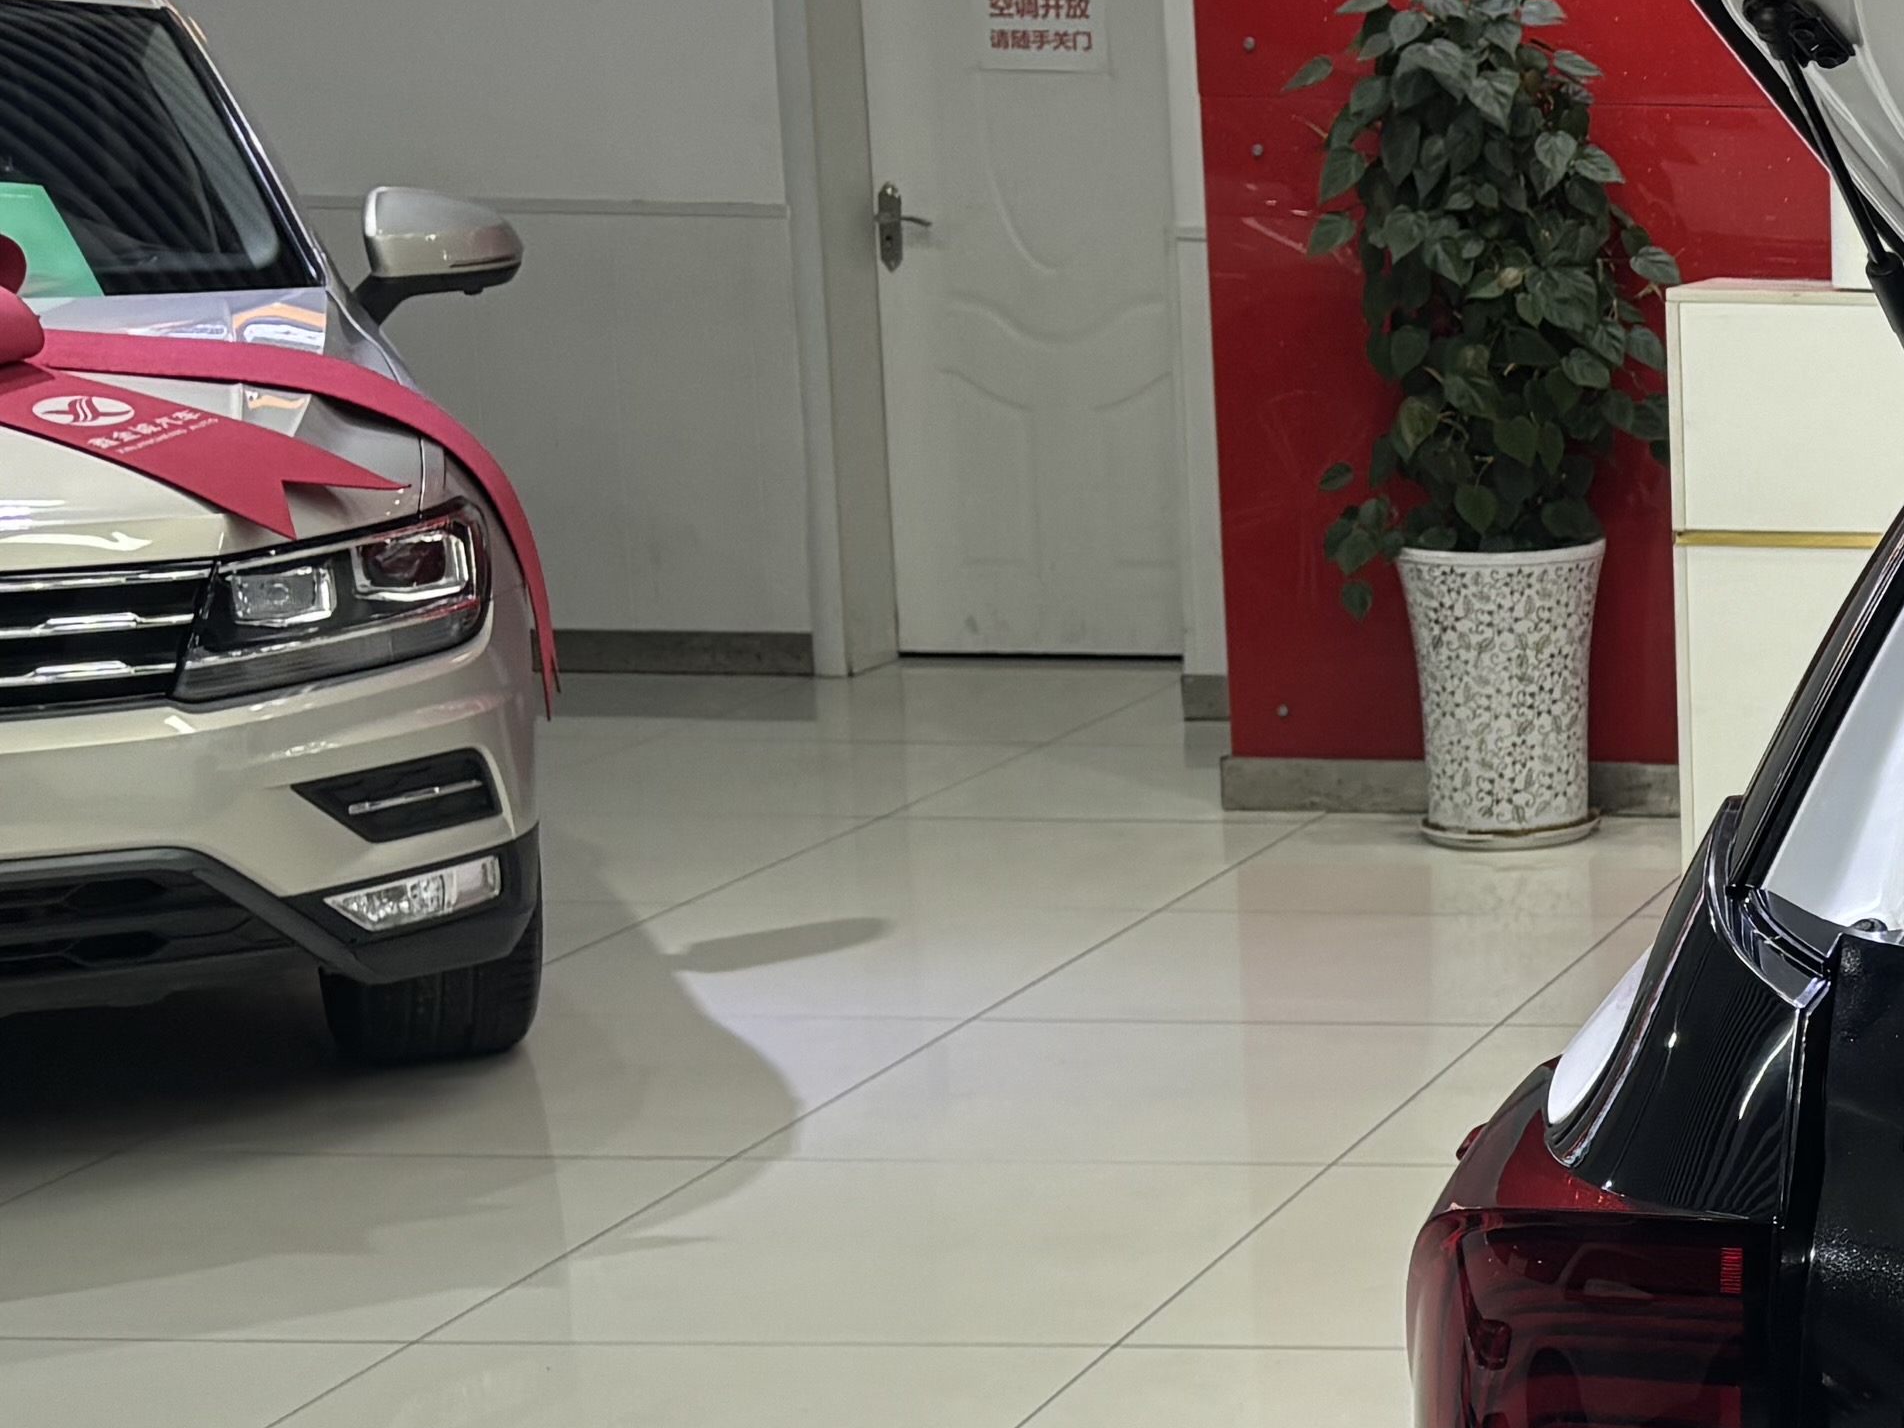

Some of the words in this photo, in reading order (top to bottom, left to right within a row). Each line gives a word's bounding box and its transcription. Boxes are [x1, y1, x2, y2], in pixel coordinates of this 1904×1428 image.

[990, 29, 1093, 52] 请随手关门
